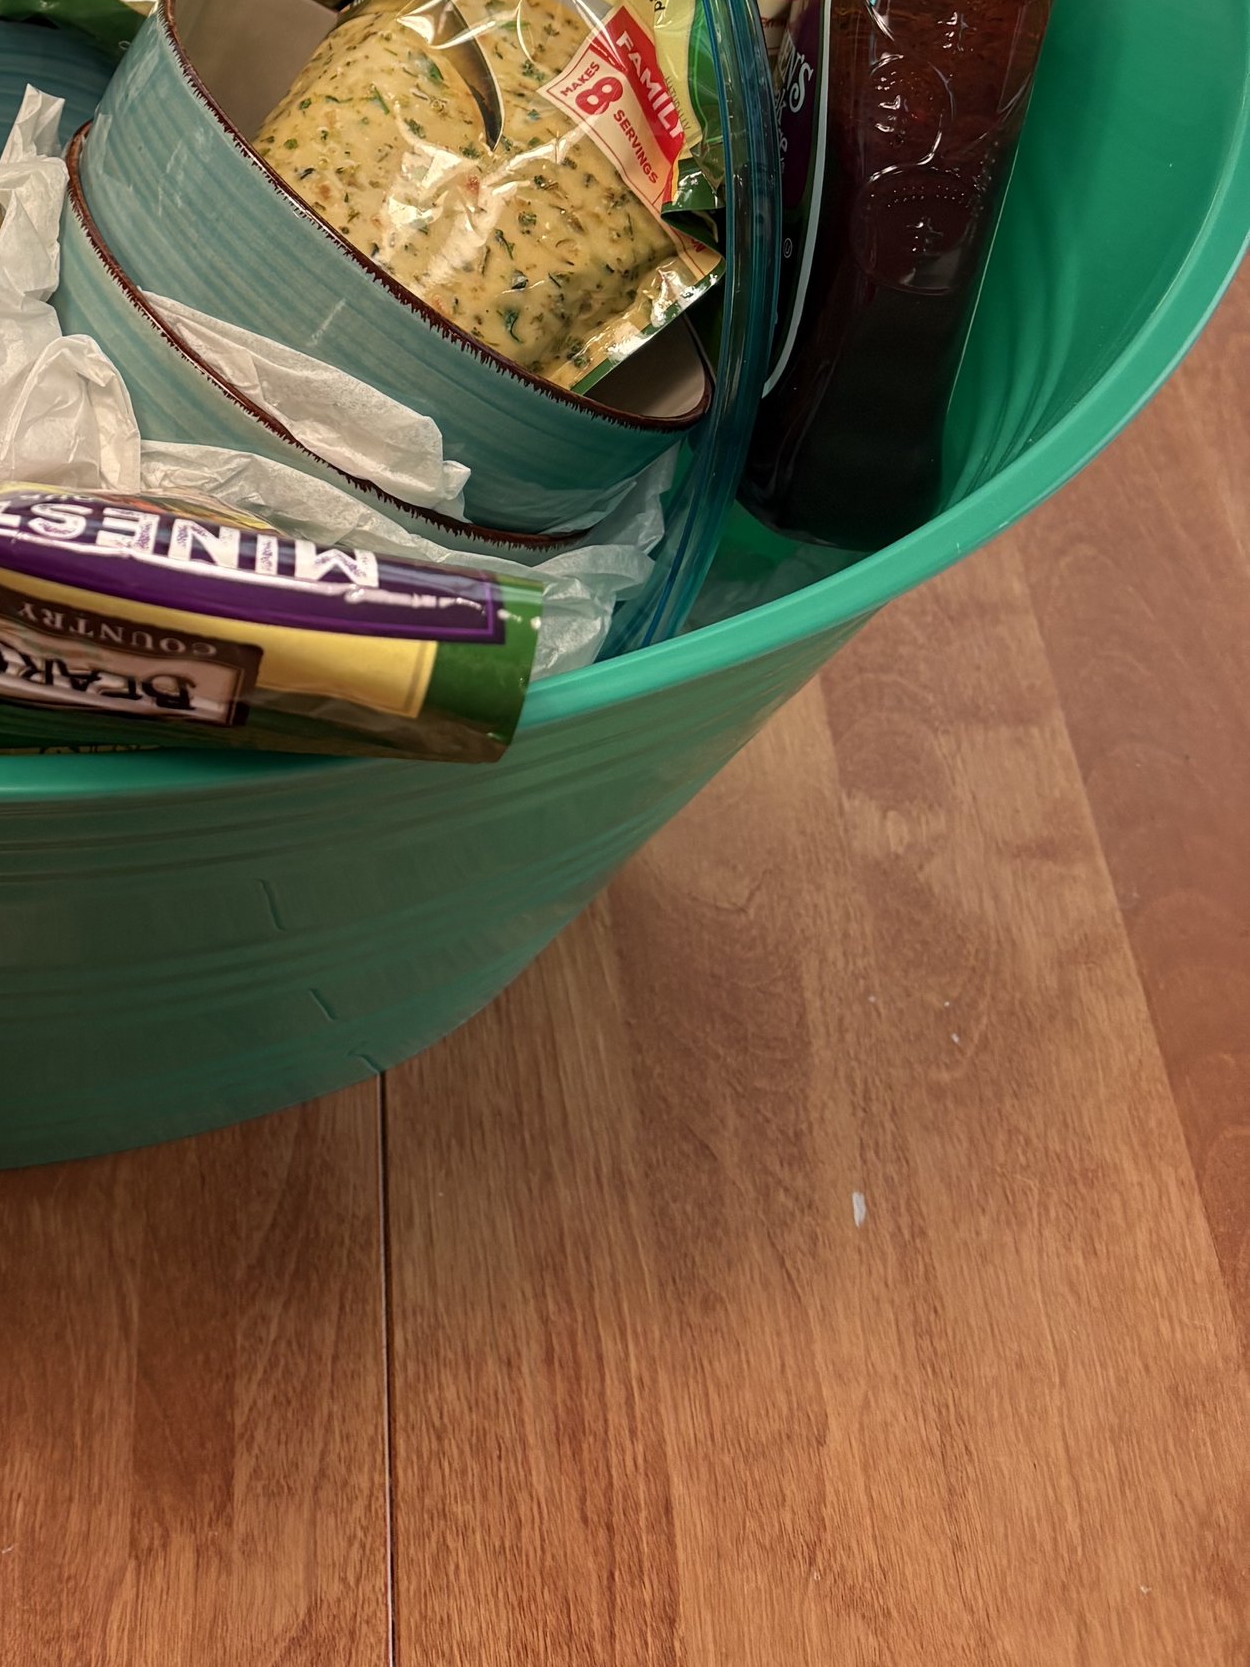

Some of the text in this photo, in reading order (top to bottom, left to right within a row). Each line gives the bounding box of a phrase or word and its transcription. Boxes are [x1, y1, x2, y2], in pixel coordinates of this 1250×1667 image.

[560, 61, 659, 184] MAKES 8 SERVINGS
[616, 31, 684, 139] FAMILY
[16, 600, 219, 660] COUNTRY
